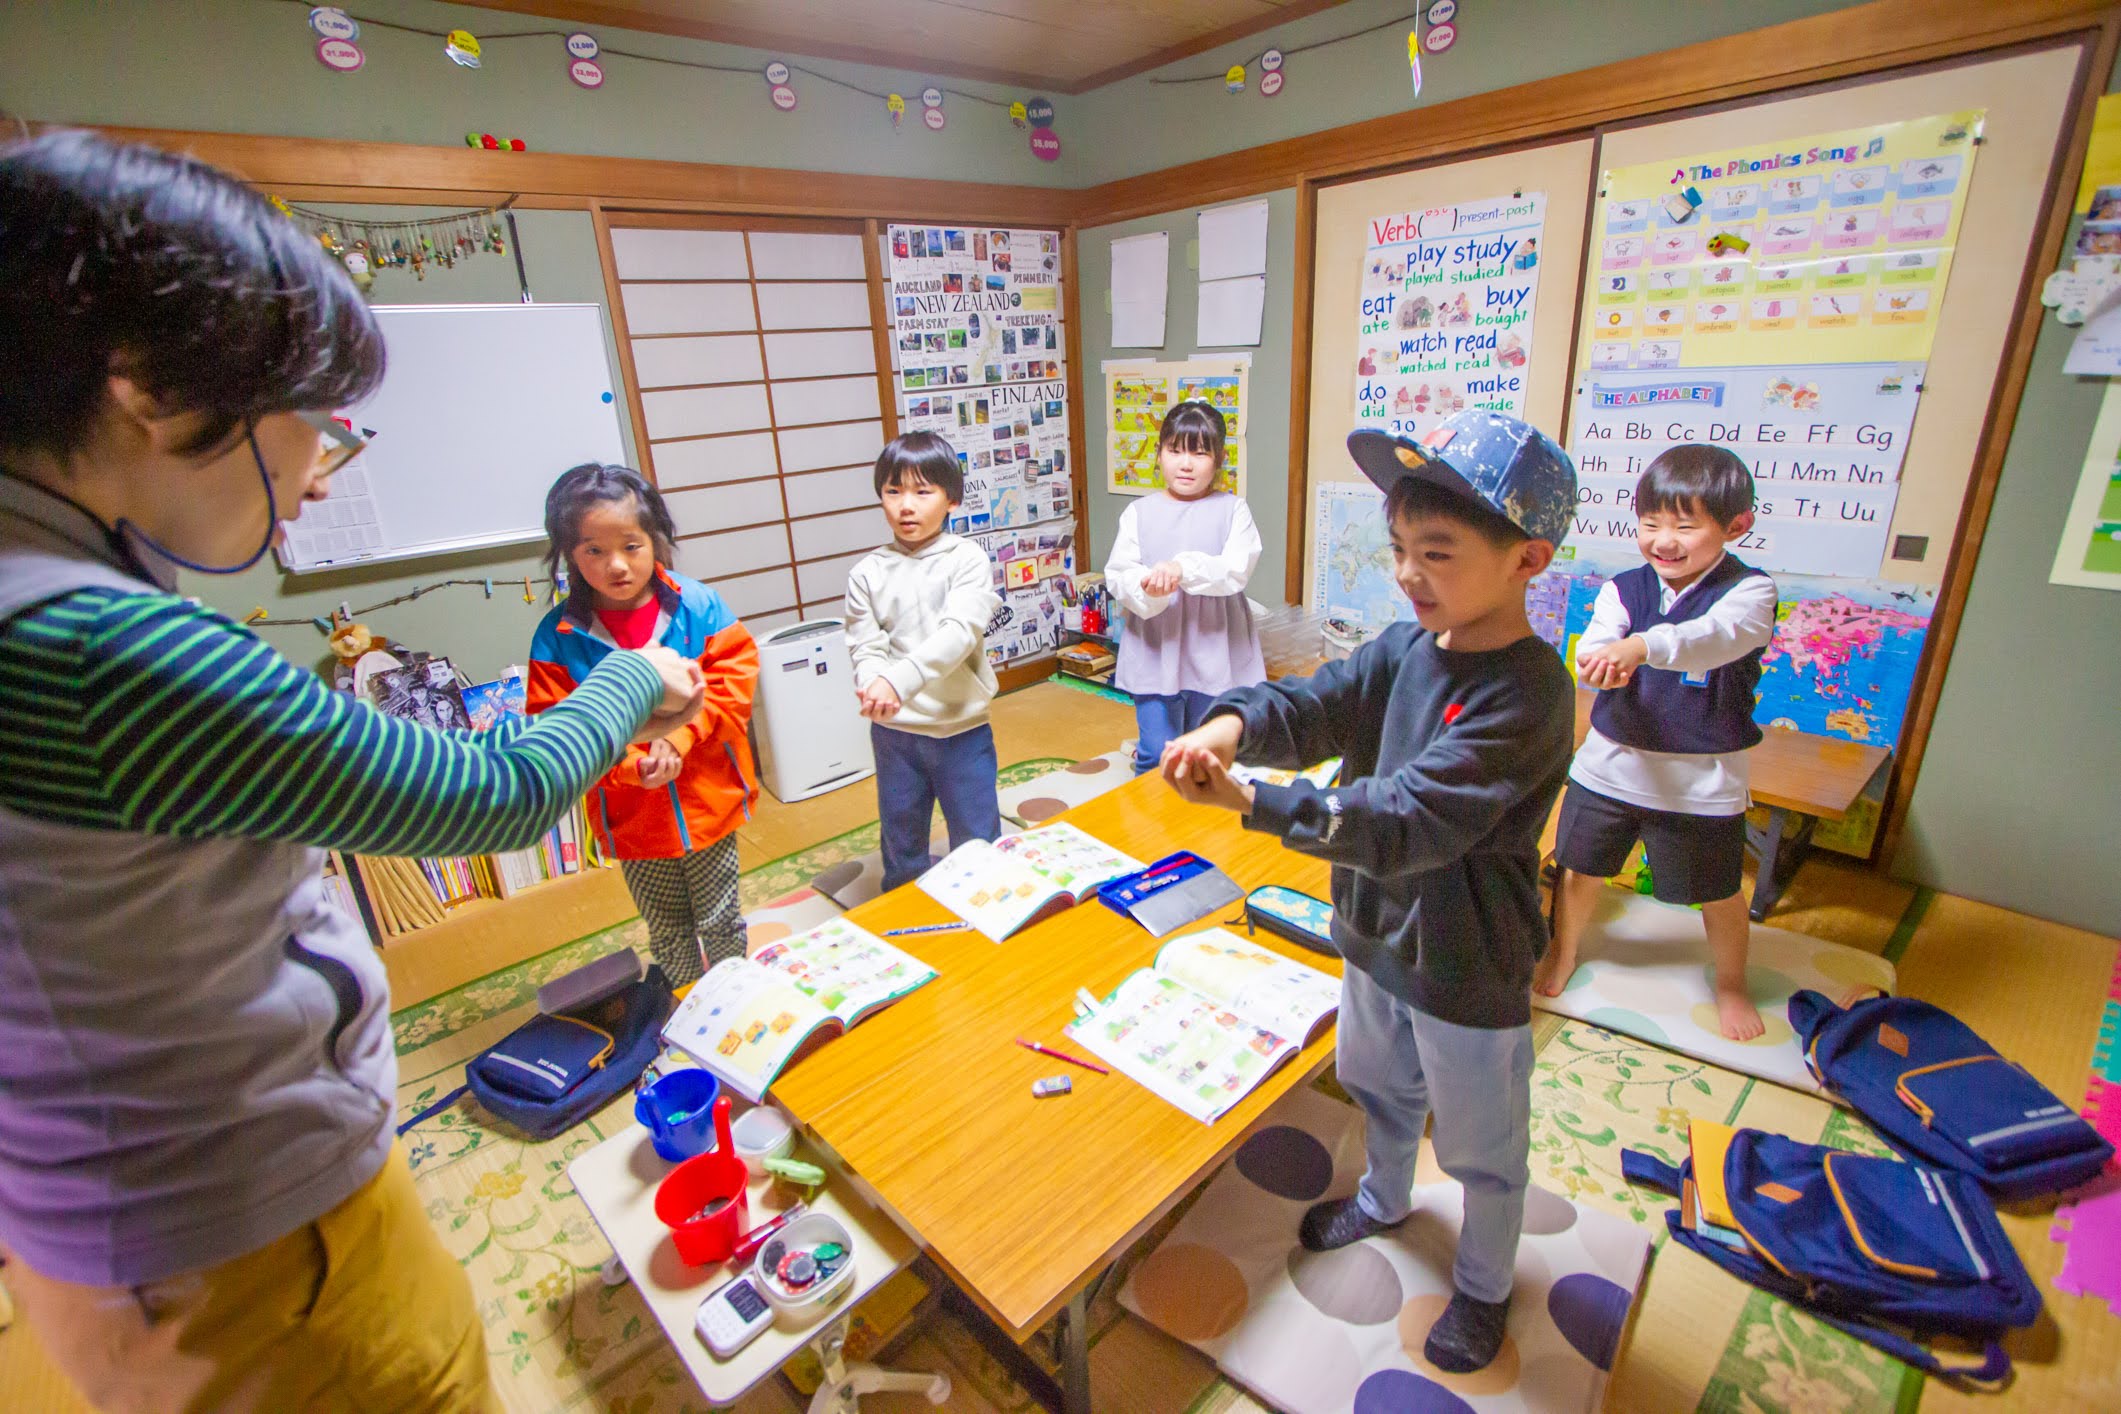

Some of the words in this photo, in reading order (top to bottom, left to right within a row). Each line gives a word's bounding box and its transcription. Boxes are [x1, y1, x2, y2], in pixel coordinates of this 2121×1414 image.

[571, 41, 594, 50] 12,000
[1429, 32, 1452, 44] 37,000
[1033, 139, 1058, 149] 35,000
[1689, 165, 1722, 181] The
[1727, 153, 1802, 177] Phonics
[1806, 146, 1859, 164] Song
[1407, 244, 1448, 273] play
[1453, 234, 1519, 264] study
[894, 279, 942, 294] AUCKLAND
[1405, 267, 1444, 292] played
[1450, 264, 1505, 285] studied
[915, 294, 948, 315] NEW
[952, 292, 1010, 313] ZEALAND
[1362, 292, 1396, 316] eat
[1486, 285, 1531, 309] buy
[898, 318, 925, 331] FARM
[925, 317, 949, 329] STAY
[1005, 314, 1046, 327] TREKKING
[1362, 320, 1390, 334] ate
[1475, 309, 1528, 330] bought
[1400, 331, 1447, 355] watch
[1455, 329, 1497, 354] read
[1400, 357, 1447, 375] watched
[1455, 353, 1490, 372] read
[991, 383, 1065, 406] FINLAND
[1359, 380, 1387, 401] do
[1467, 374, 1520, 394] make
[1594, 392, 1623, 405] THE
[1628, 387, 1713, 404] ALPHABET
[1361, 404, 1385, 417] did
[1585, 422, 1611, 439] Aa
[1626, 422, 1652, 440] Bb
[1666, 423, 1695, 440] Cc
[1709, 422, 1741, 441] Dd
[1757, 424, 1786, 442] Ee
[1807, 424, 1838, 443] Ff
[1856, 424, 1893, 451] Gg
[1581, 455, 1607, 472] Hh
[1626, 456, 1642, 473] Ii
[1754, 460, 1777, 479] Ll
[1791, 462, 1836, 481] Mm
[1848, 464, 1883, 483] Nn
[1578, 487, 1603, 504] Oo
[1794, 498, 1821, 517] Tt
[1840, 501, 1875, 521] Uu
[1575, 518, 1598, 535] Vv
[1737, 531, 1767, 549] Zz
